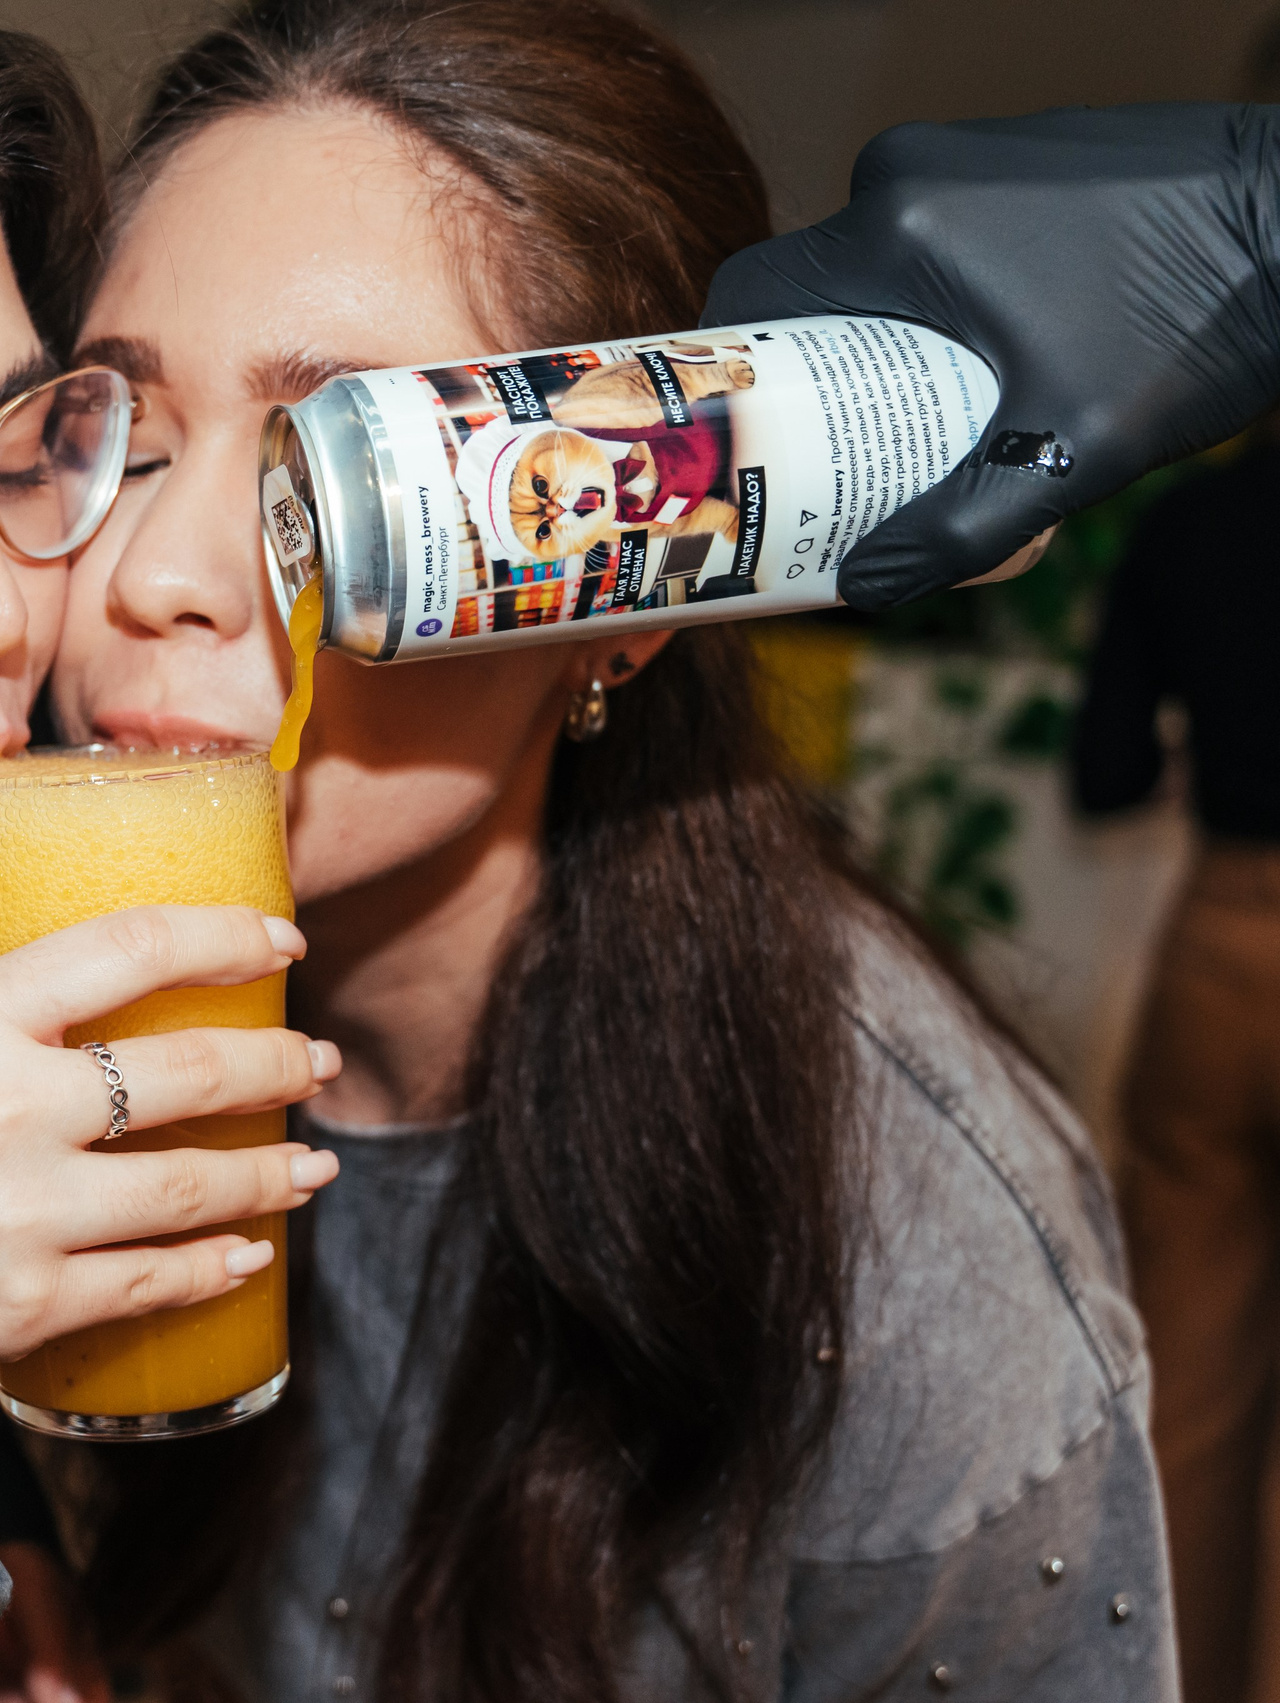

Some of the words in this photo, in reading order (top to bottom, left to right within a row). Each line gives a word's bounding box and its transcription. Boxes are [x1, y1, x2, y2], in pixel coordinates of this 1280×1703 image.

[785, 331, 807, 351] саура?
[802, 330, 824, 352] требуй
[840, 334, 851, 342] на
[845, 321, 876, 361] ананасовым
[864, 324, 887, 349] пивную
[879, 320, 897, 338] жизнь
[902, 328, 919, 349] брать
[645, 353, 669, 380] КЛЮЧ!
[802, 353, 821, 382] вместо
[848, 344, 868, 379] очередь
[882, 350, 897, 371] твою
[892, 340, 915, 370] утиную
[914, 351, 931, 376] Пакет
[823, 361, 843, 398] скандал
[838, 356, 856, 390] хочешь
[873, 363, 890, 400] свежим
[497, 371, 527, 414] ПАСПОРТ
[508, 366, 542, 419] ПОКАЖИТЕ!
[664, 382, 685, 423] НЕСИТЕ
[816, 385, 831, 410] стаут
[851, 393, 860, 405] ты
[863, 382, 875, 398] как
[896, 382, 913, 416] упасть
[908, 372, 928, 419] грустную
[927, 379, 940, 406] вайб.
[954, 369, 972, 411] #ананас
[837, 401, 852, 434] Учини
[856, 408, 869, 445] только
[868, 401, 886, 451] плотный,
[935, 409, 946, 437] плюс
[825, 413, 842, 463] Пробили
[888, 412, 906, 479] грейпфрута
[906, 419, 918, 458] обязан
[922, 423, 935, 479] отменяем
[938, 441, 949, 465] тебе
[864, 448, 872, 462] не
[881, 455, 891, 483] саур,
[865, 465, 875, 491] ведь
[746, 473, 760, 523] НАДО?
[817, 469, 845, 573] magic_mess_brewery
[846, 515, 856, 530] нас
[418, 486, 434, 612] magic_mess_brewery
[621, 541, 632, 565] НАС
[737, 526, 758, 575] ПАКЕТИК
[437, 527, 450, 610] Санкт-Петербург
[629, 549, 645, 592] ОТМЕНА!
[615, 576, 629, 601] ГАЛЯ,
